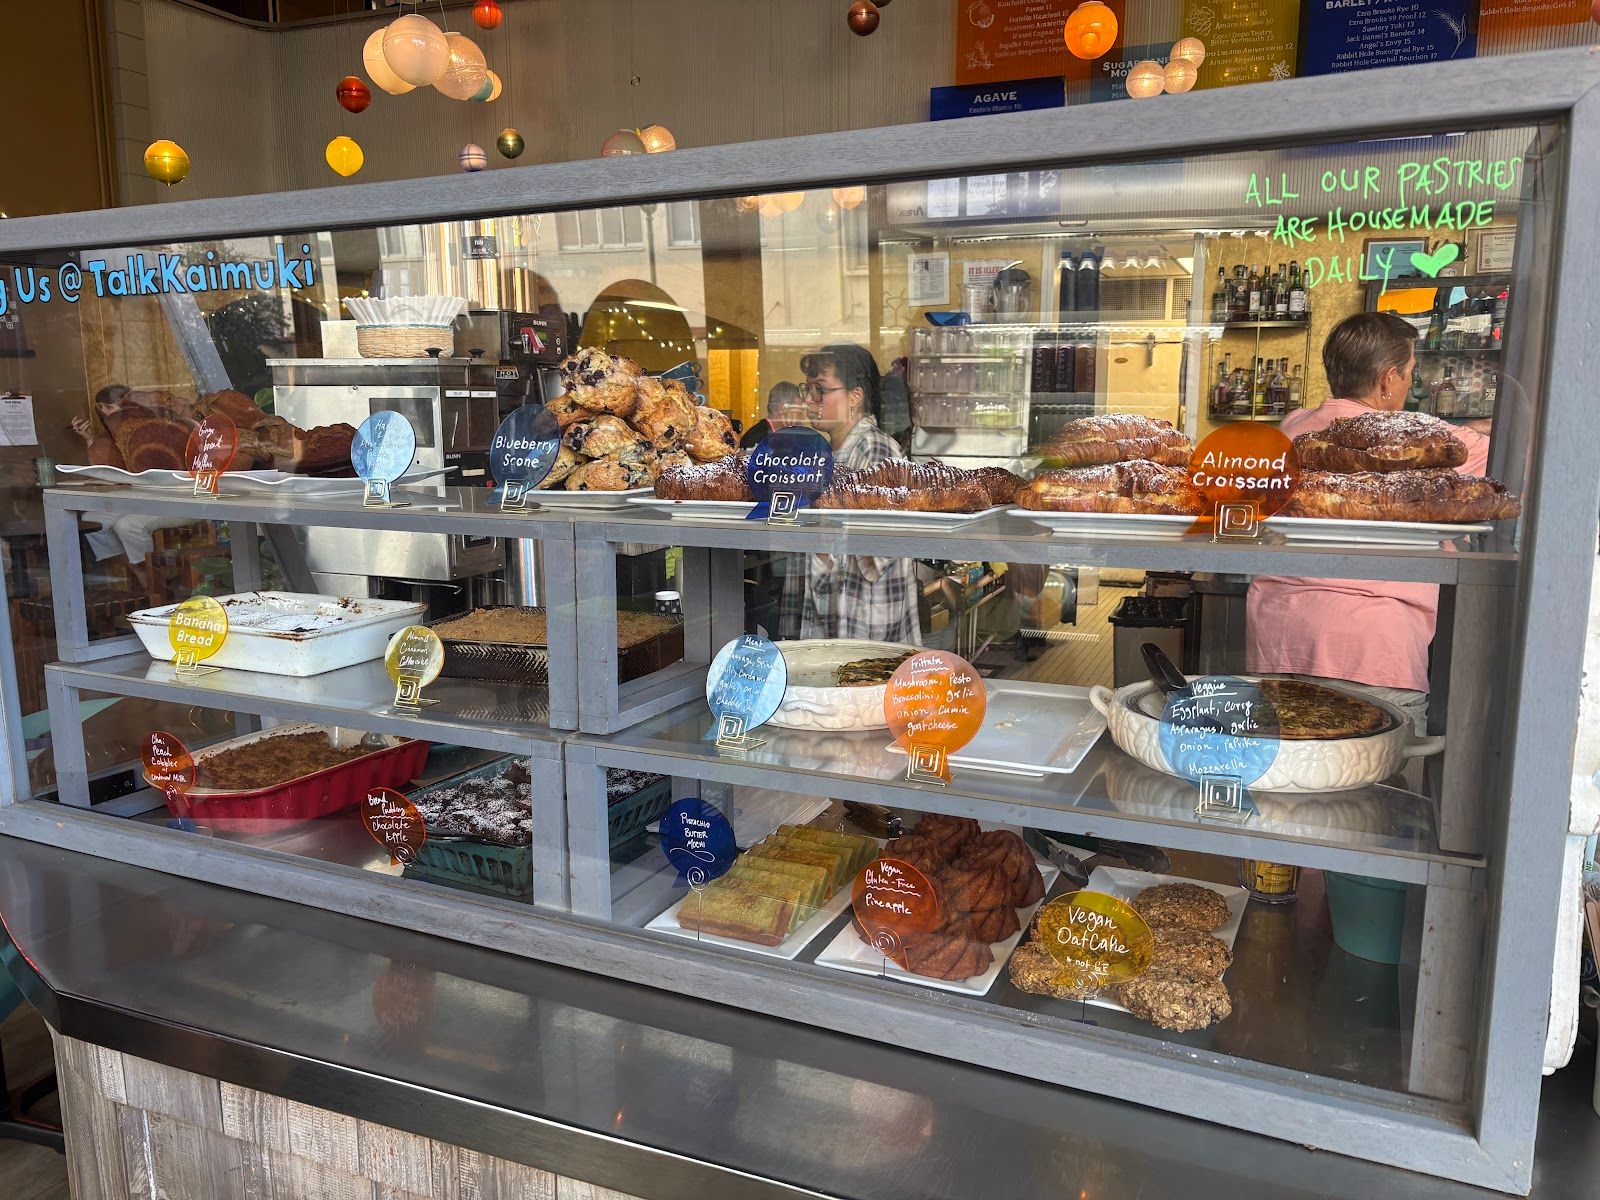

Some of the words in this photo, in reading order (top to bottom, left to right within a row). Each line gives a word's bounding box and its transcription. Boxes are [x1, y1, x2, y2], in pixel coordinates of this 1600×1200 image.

[1364, 16, 1387, 25] Brooks
[1397, 11, 1417, 20] Proof
[1372, 8, 1395, 16] Brooks
[1479, 8, 1503, 17] Rabbit
[1504, 6, 1521, 14] Hole
[1362, 25, 1389, 33] Suntory
[1406, 20, 1415, 28] 13
[1346, 35, 1362, 43] Jack
[1390, 29, 1416, 37] Bonded
[1358, 41, 1384, 50] Angel's
[1385, 38, 1403, 47] Envy
[1336, 52, 1358, 61] Rabbit
[1358, 50, 1375, 58] Hole
[1412, 44, 1425, 53] Rye
[1426, 43, 1435, 51] 15
[1331, 60, 1353, 69] Rabbit
[1353, 58, 1370, 67] Hole
[1399, 53, 1429, 62] Bourbon
[1430, 52, 1439, 60] 17
[973, 91, 1018, 104] AGAVE
[1246, 172, 1300, 208] ALL
[1320, 165, 1381, 200] OUR
[1397, 156, 1523, 208] PASTRIES
[1272, 214, 1319, 249] ARE
[1327, 198, 1497, 244] HOUSEMADE
[14, 265, 52, 305] Us
[57, 260, 83, 304] @
[87, 242, 316, 299] TalkKaimuki
[1305, 246, 1396, 297] DAILY
[495, 435, 556, 455] Blueberry
[503, 453, 540, 469] Scone
[755, 451, 827, 467] Chocolate
[1200, 450, 1287, 473] Almond
[753, 469, 823, 484] Croissant
[1191, 471, 1293, 490] Croissant
[175, 612, 223, 633] Banana
[176, 629, 214, 647] Bread
[744, 636, 765, 647] Meat
[949, 672, 972, 687] Pesto
[946, 687, 976, 703] garlic
[1230, 717, 1260, 735] garlic
[152, 744, 173, 757] Peach
[1187, 758, 1248, 775] Mozzarella
[880, 861, 903, 877] Vegan
[865, 892, 912, 915] Pineapple
[1068, 906, 1118, 932] Vegan
[1075, 959, 1091, 968] not
